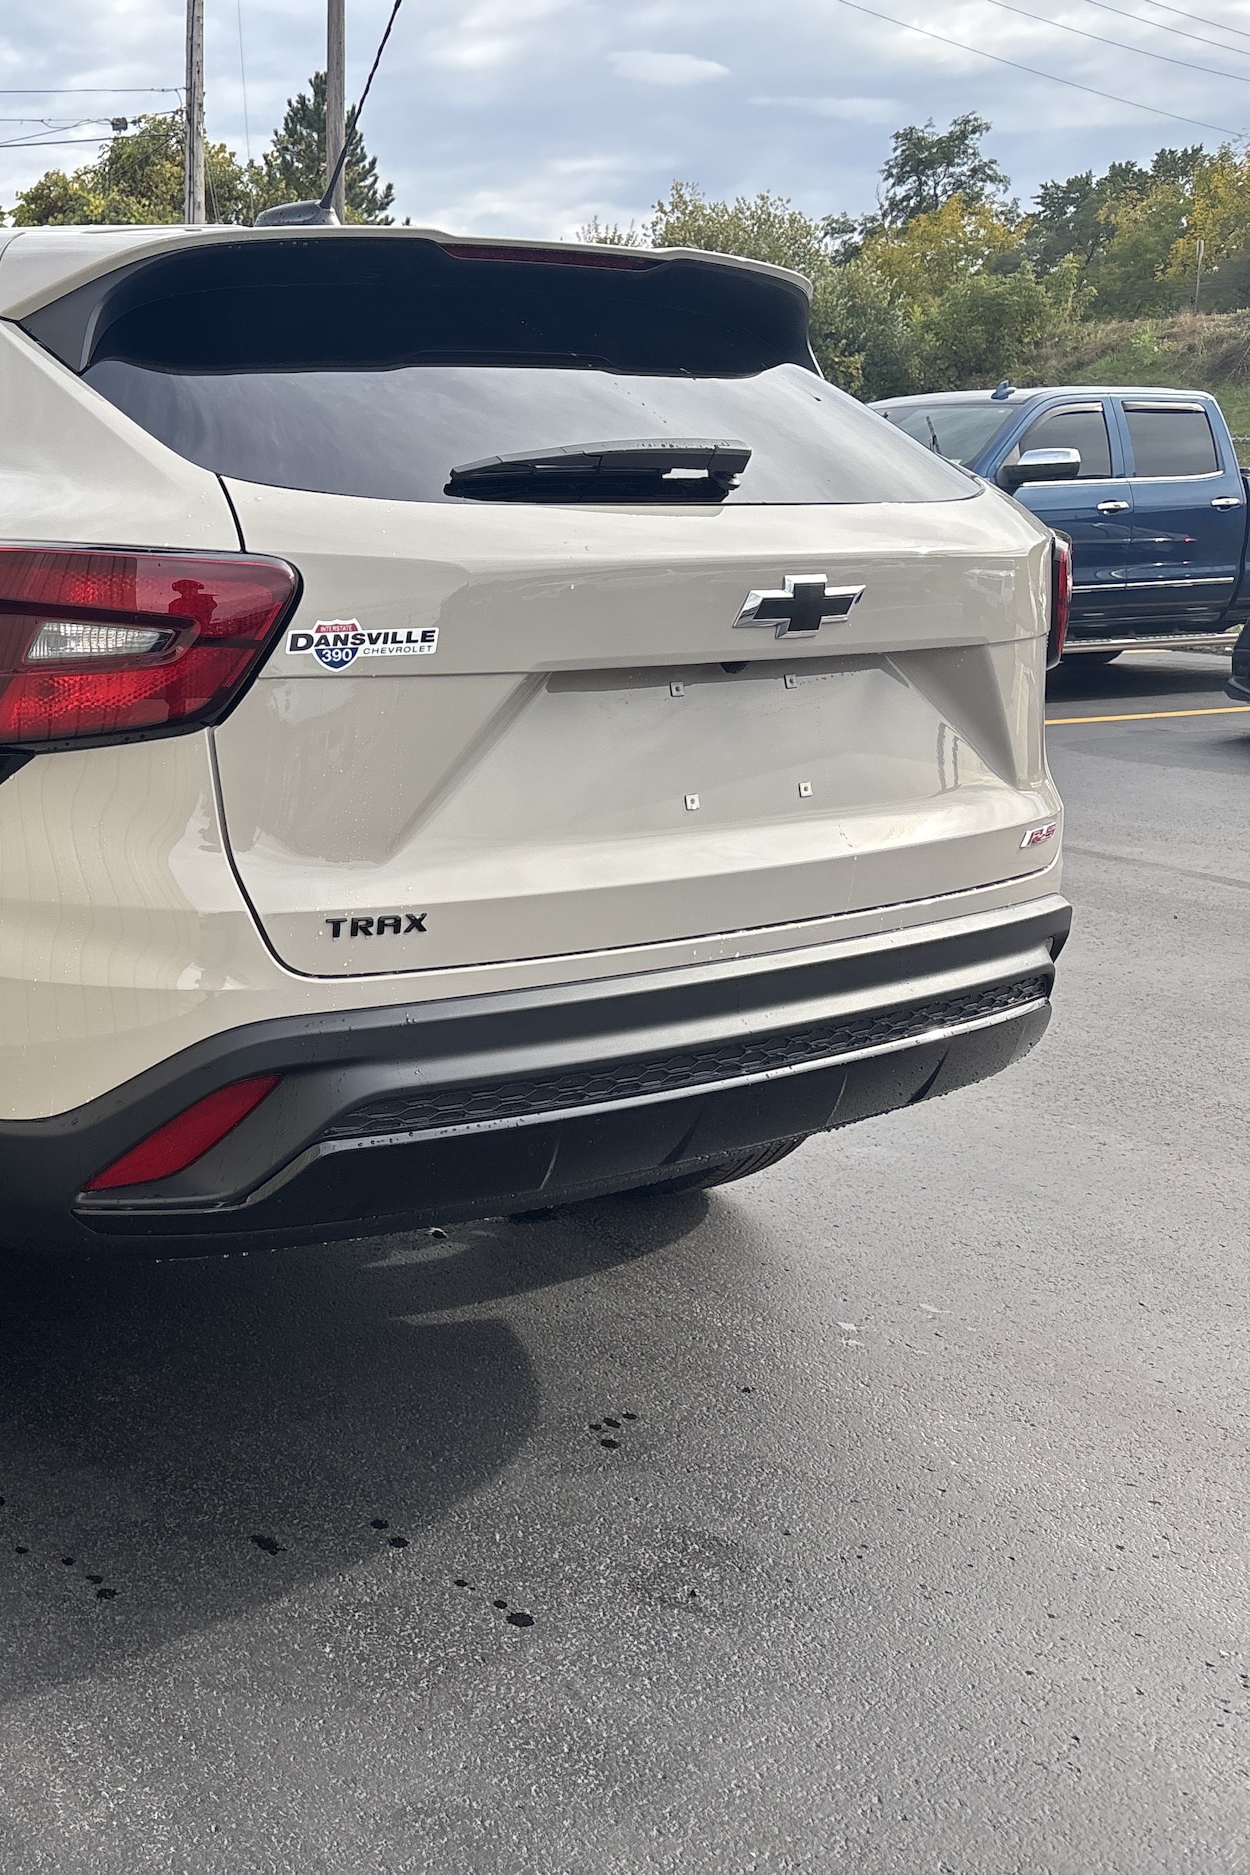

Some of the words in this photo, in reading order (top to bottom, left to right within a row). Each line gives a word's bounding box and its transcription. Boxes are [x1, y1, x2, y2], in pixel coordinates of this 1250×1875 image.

[320, 624, 353, 632] INTERSTATE
[289, 630, 436, 652] DANSVILLE
[363, 645, 433, 655] CHEVROLET
[321, 648, 353, 662] 390
[1022, 822, 1056, 847] RS
[325, 913, 427, 938] TRAX
